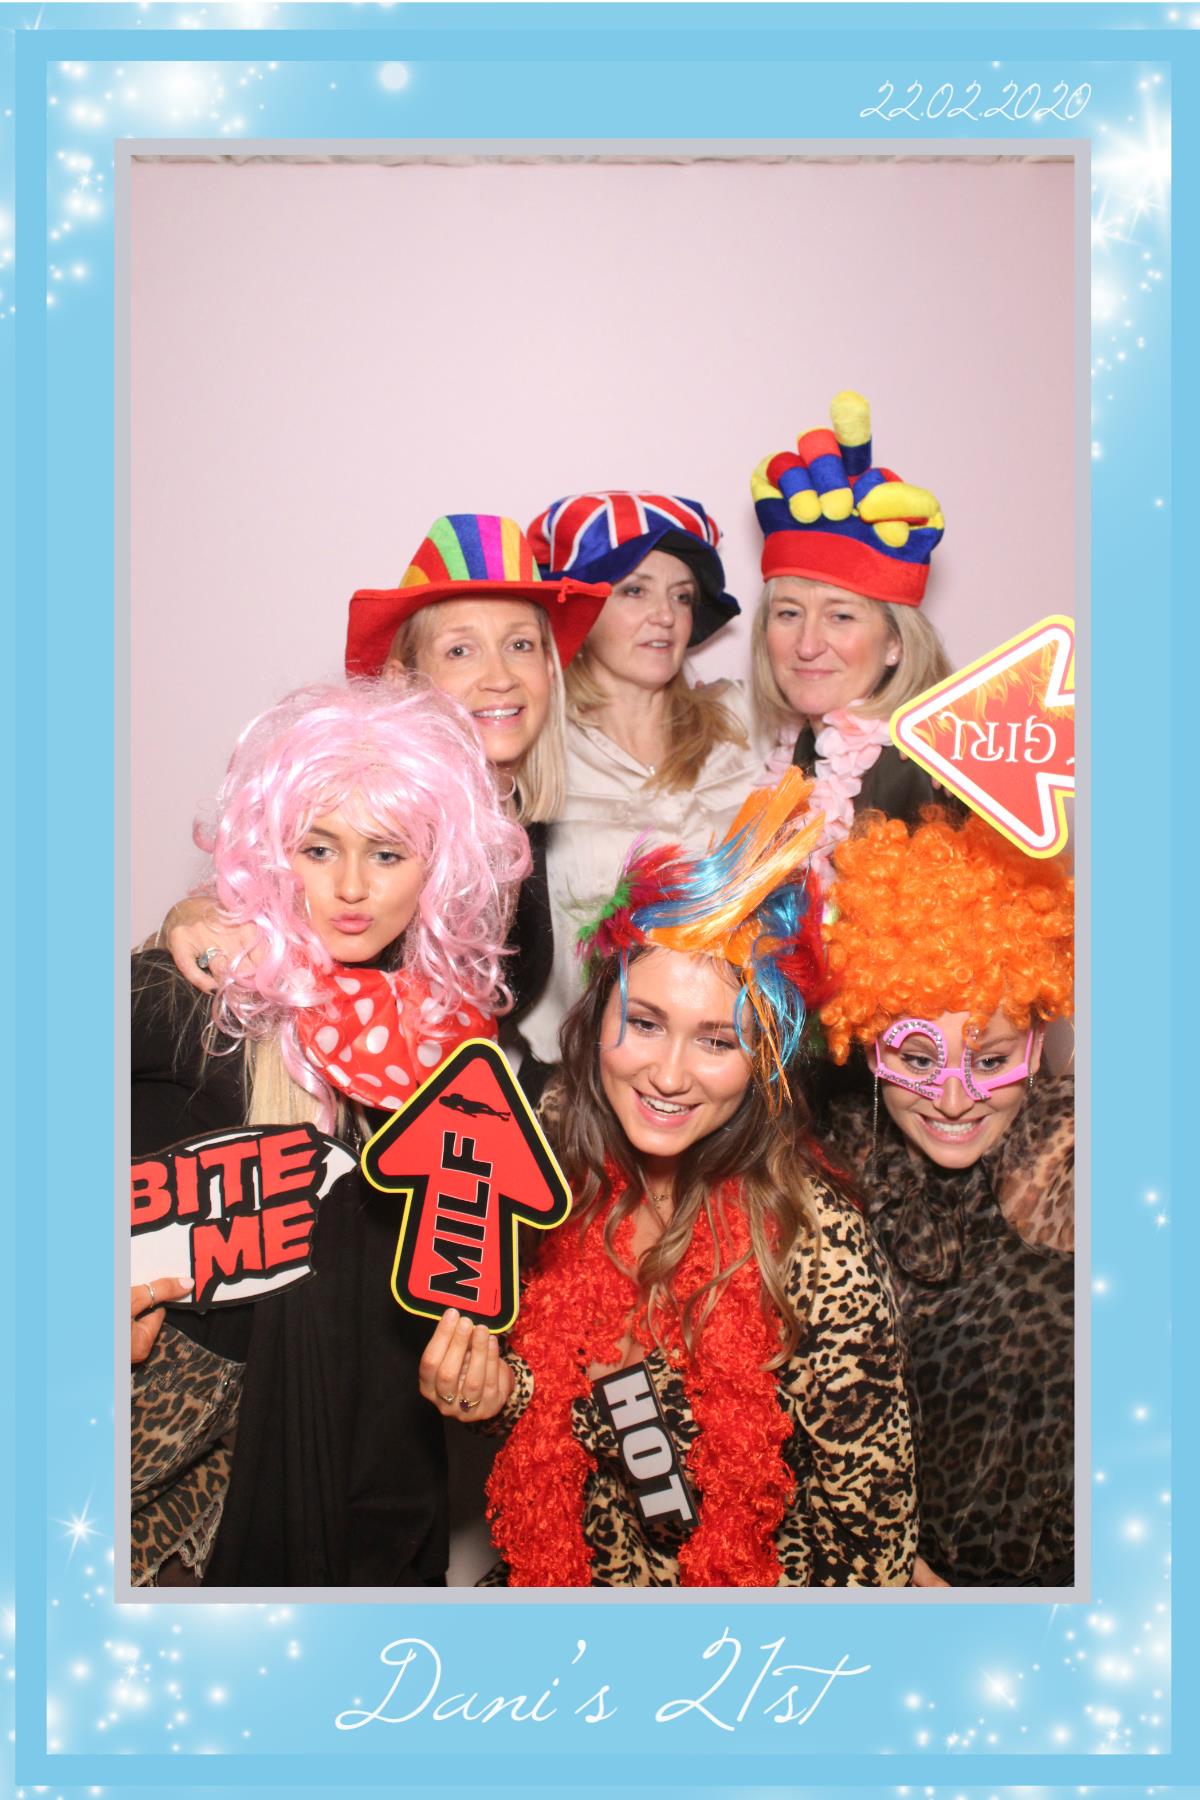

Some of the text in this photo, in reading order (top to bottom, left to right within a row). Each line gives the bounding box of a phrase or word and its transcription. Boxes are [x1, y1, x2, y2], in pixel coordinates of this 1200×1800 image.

[131, 1129, 318, 1226] BITE
[428, 1130, 494, 1302] MILF
[193, 1200, 315, 1302] ME
[603, 1370, 693, 1521] HOT
